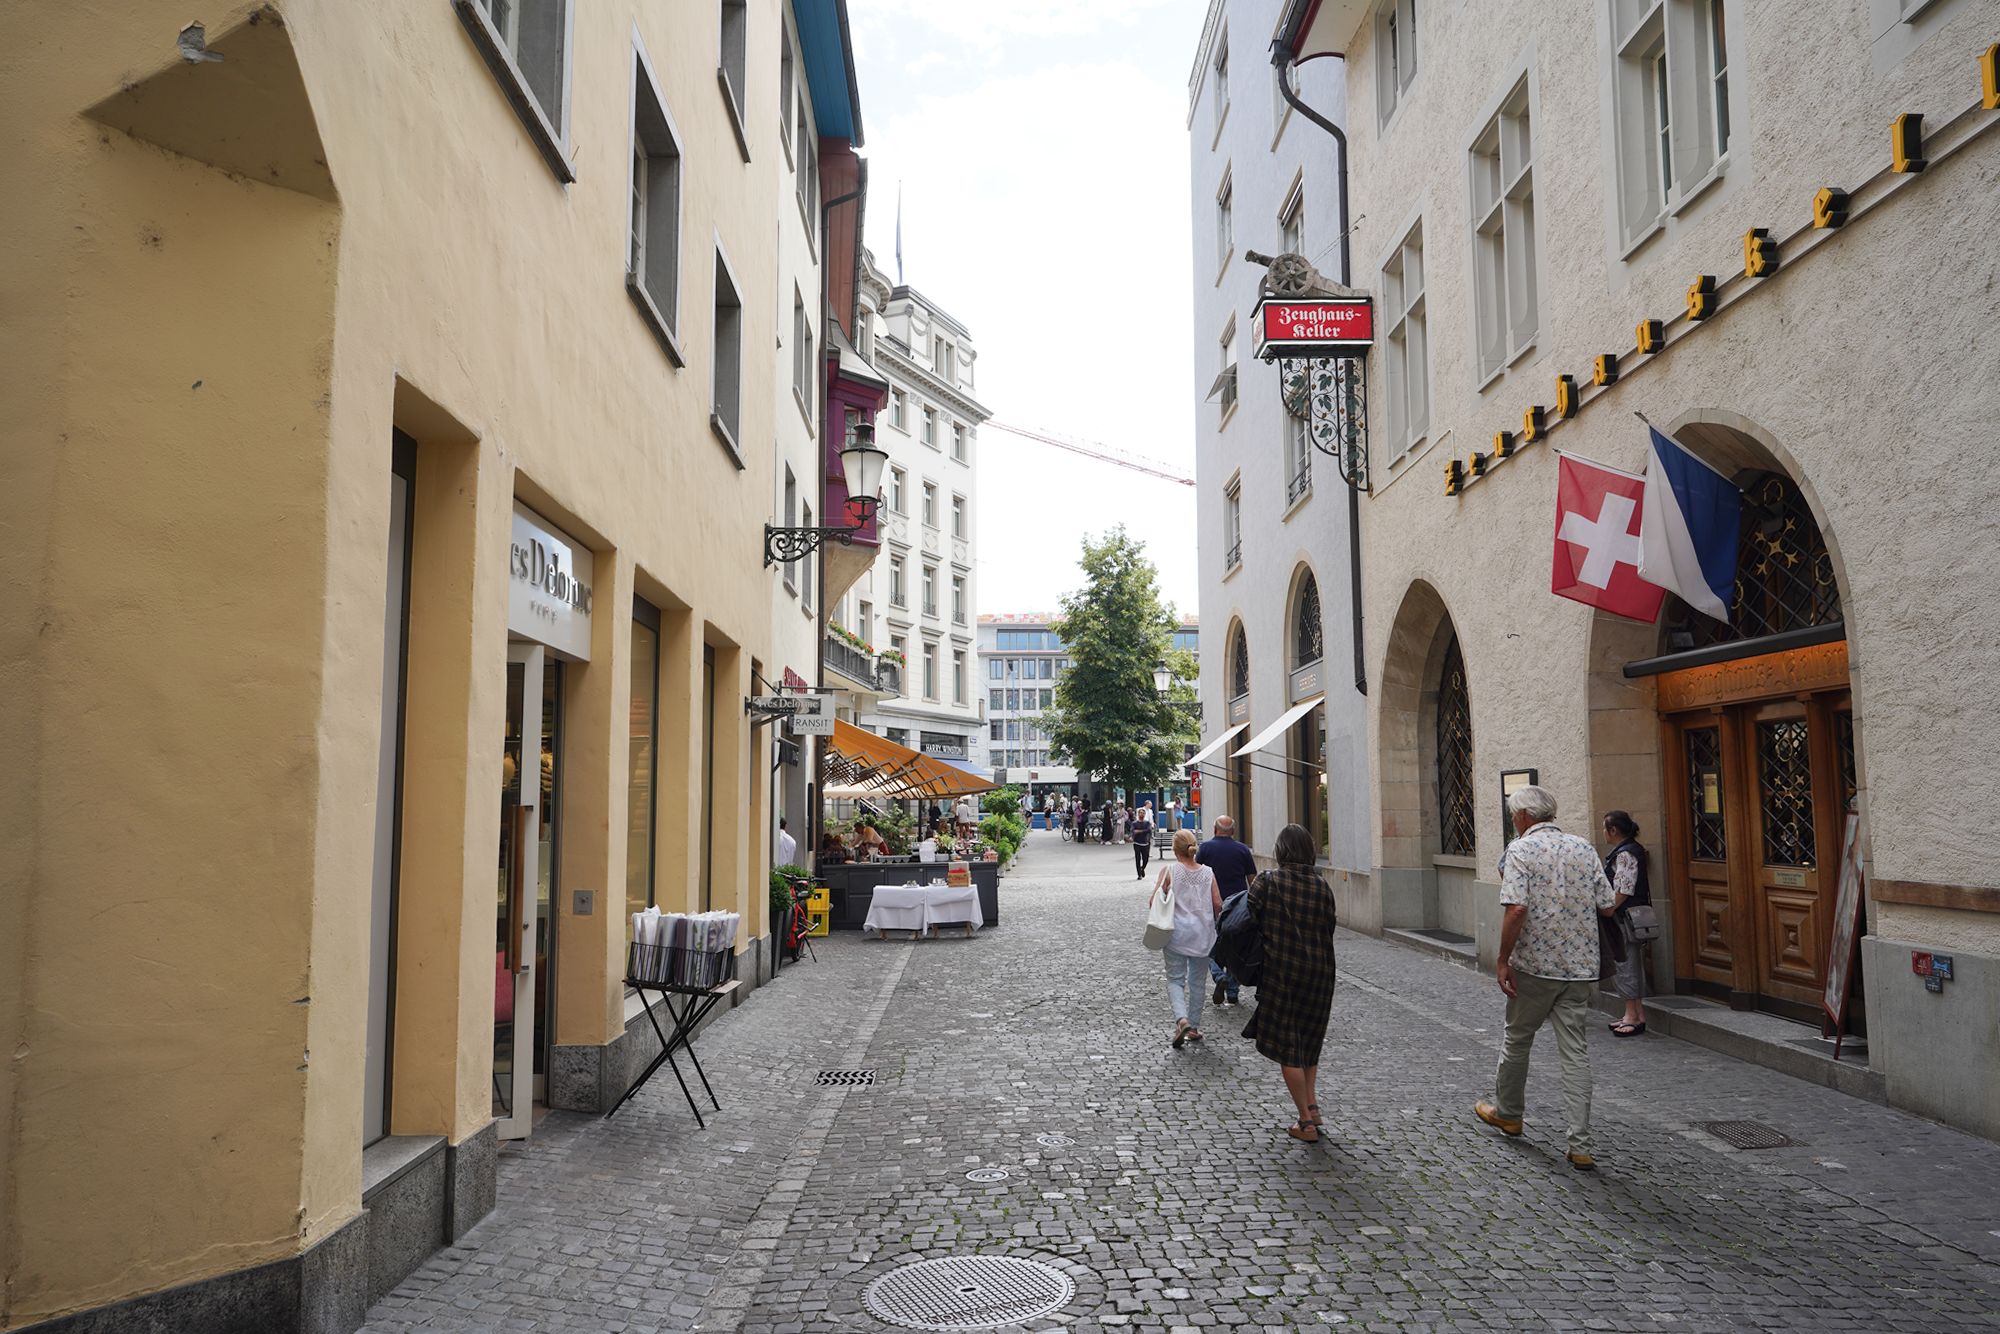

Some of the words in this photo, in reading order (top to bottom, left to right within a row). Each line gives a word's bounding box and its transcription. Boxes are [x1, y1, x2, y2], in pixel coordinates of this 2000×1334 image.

[1278, 306, 1362, 325] Zeughaus-
[1292, 323, 1341, 338] Keller
[925, 743, 941, 753] HARRY
[928, 1294, 1057, 1325] KANALISATION
